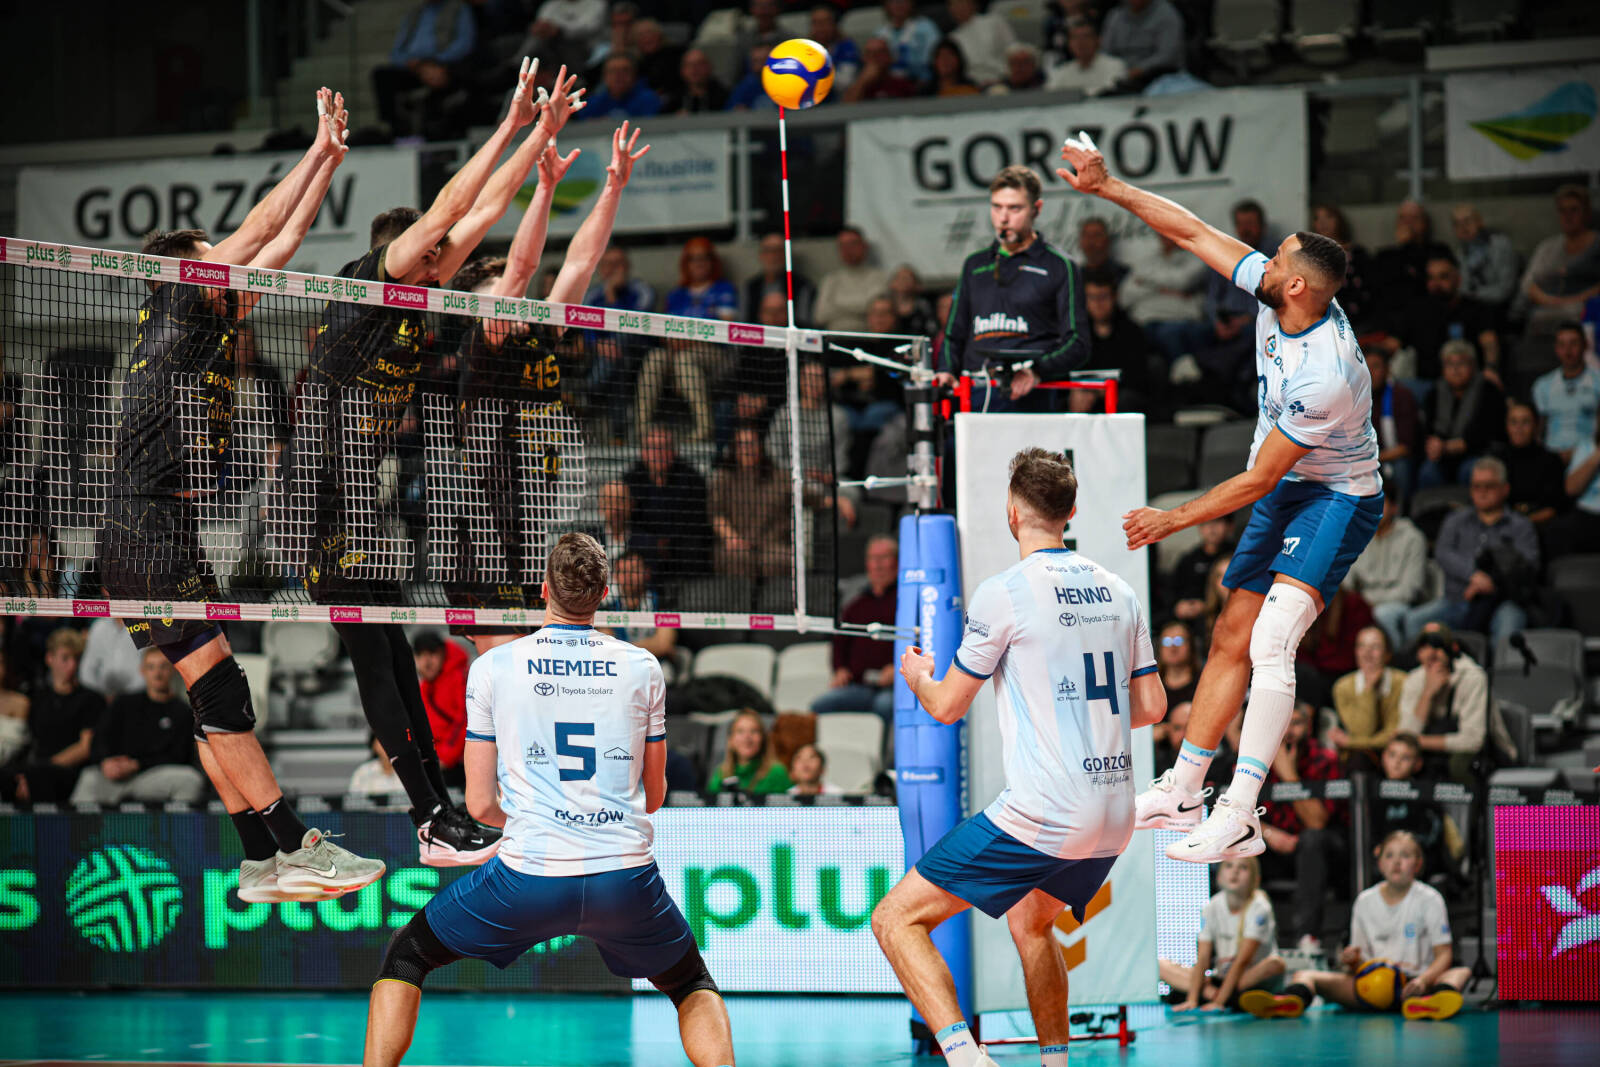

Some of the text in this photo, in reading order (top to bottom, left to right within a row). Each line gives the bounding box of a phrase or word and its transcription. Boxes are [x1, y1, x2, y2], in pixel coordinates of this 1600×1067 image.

[913, 106, 1233, 192] GORÓW
[26, 242, 55, 263] plus
[91, 250, 161, 278] plus liga
[195, 267, 226, 281] TAURON
[248, 269, 272, 288] plus
[304, 276, 367, 301] plus liga
[396, 291, 425, 304] TAURON
[443, 293, 466, 311] plus
[494, 298, 551, 322] plus liga
[618, 312, 639, 330] plus
[664, 318, 685, 335] plus
[1054, 586, 1113, 605] HENNO
[5, 599, 26, 613] plus
[84, 604, 107, 613] TAURON
[143, 602, 163, 617] plus
[217, 607, 238, 616] TAURON
[271, 607, 289, 619] plus
[390, 609, 408, 622] plus
[502, 612, 518, 623] plus
[1080, 615, 1102, 625] Toyota
[536, 636, 603, 648] plus liga
[527, 658, 618, 677] NIEMIEC
[561, 686, 614, 696] Toyota Stolarz
[1083, 651, 1120, 715] 4
[554, 721, 596, 781] 5
[1083, 752, 1132, 772] GORZÓW
